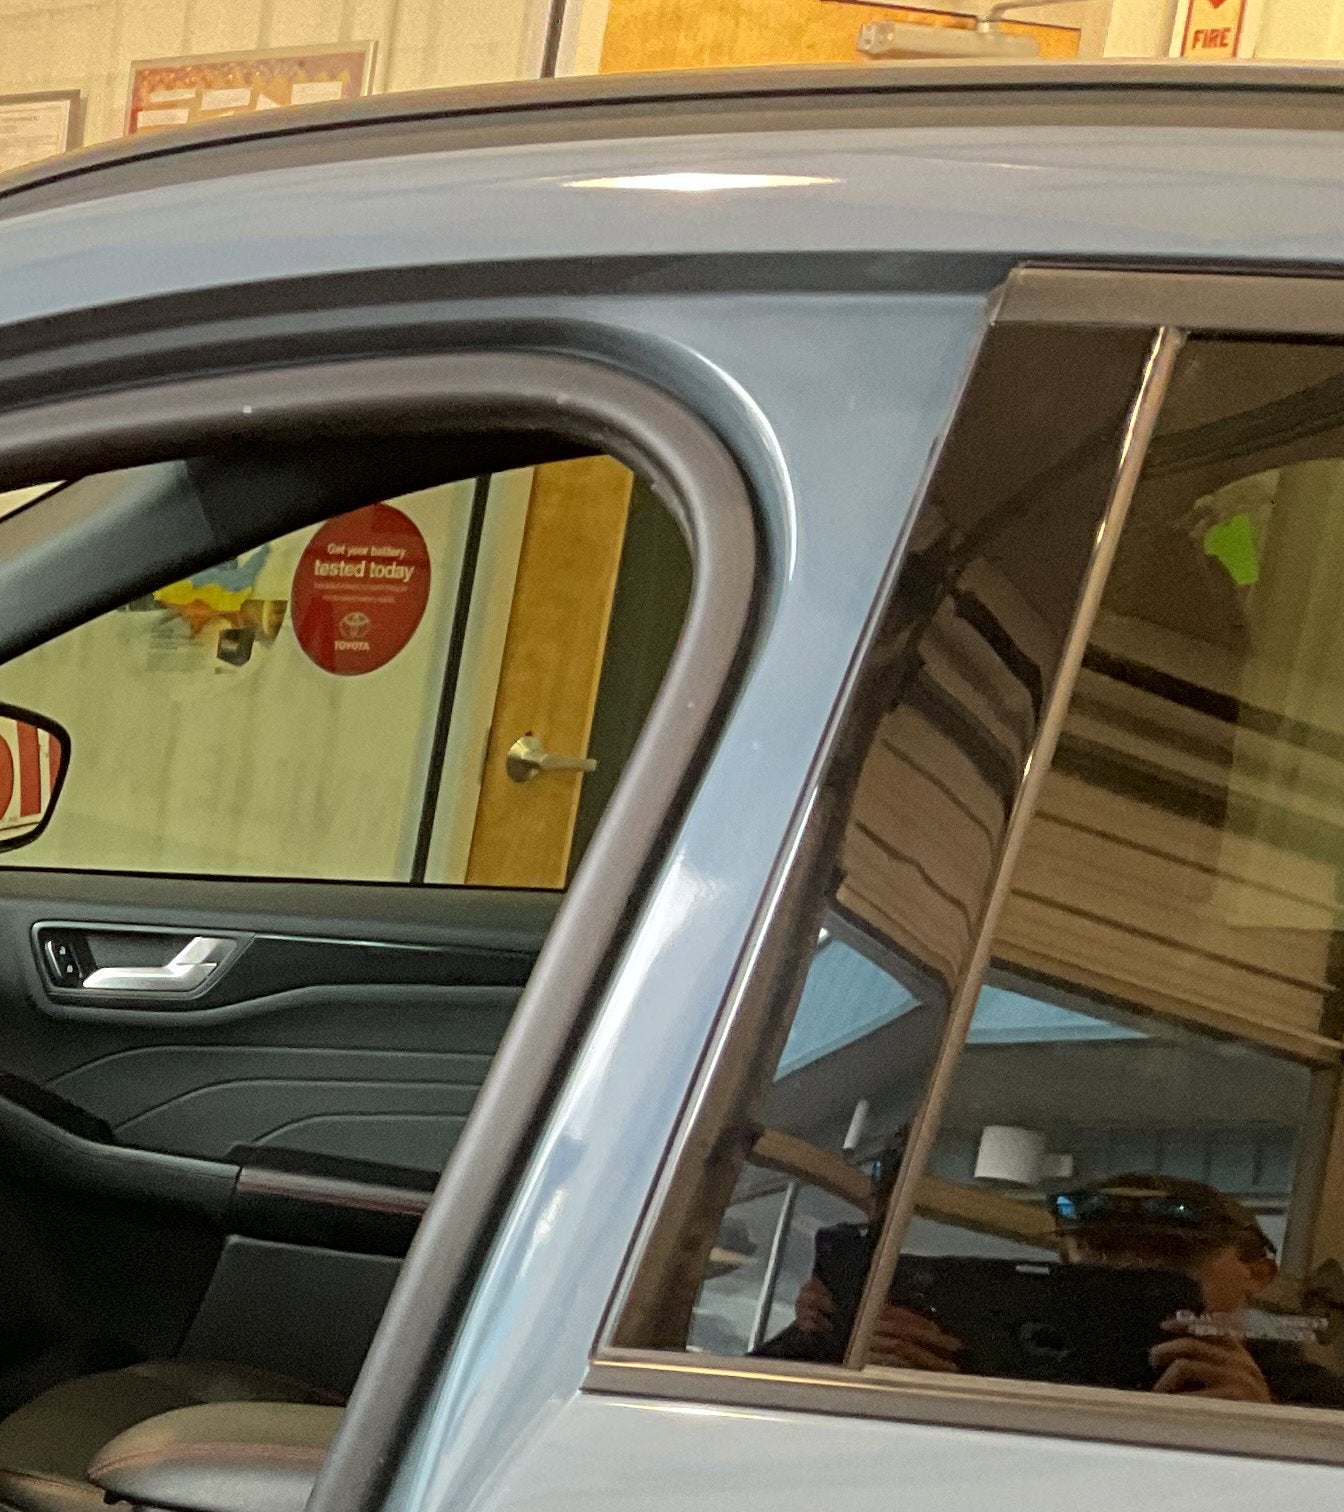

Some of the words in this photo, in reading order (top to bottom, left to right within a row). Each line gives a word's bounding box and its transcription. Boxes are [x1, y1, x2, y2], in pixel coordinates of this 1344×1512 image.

[1192, 27, 1231, 49] FIRE
[327, 543, 345, 555] Get
[347, 546, 368, 557] your
[314, 559, 366, 577] tested
[369, 561, 415, 583] today
[334, 640, 370, 651] TOYOTA
